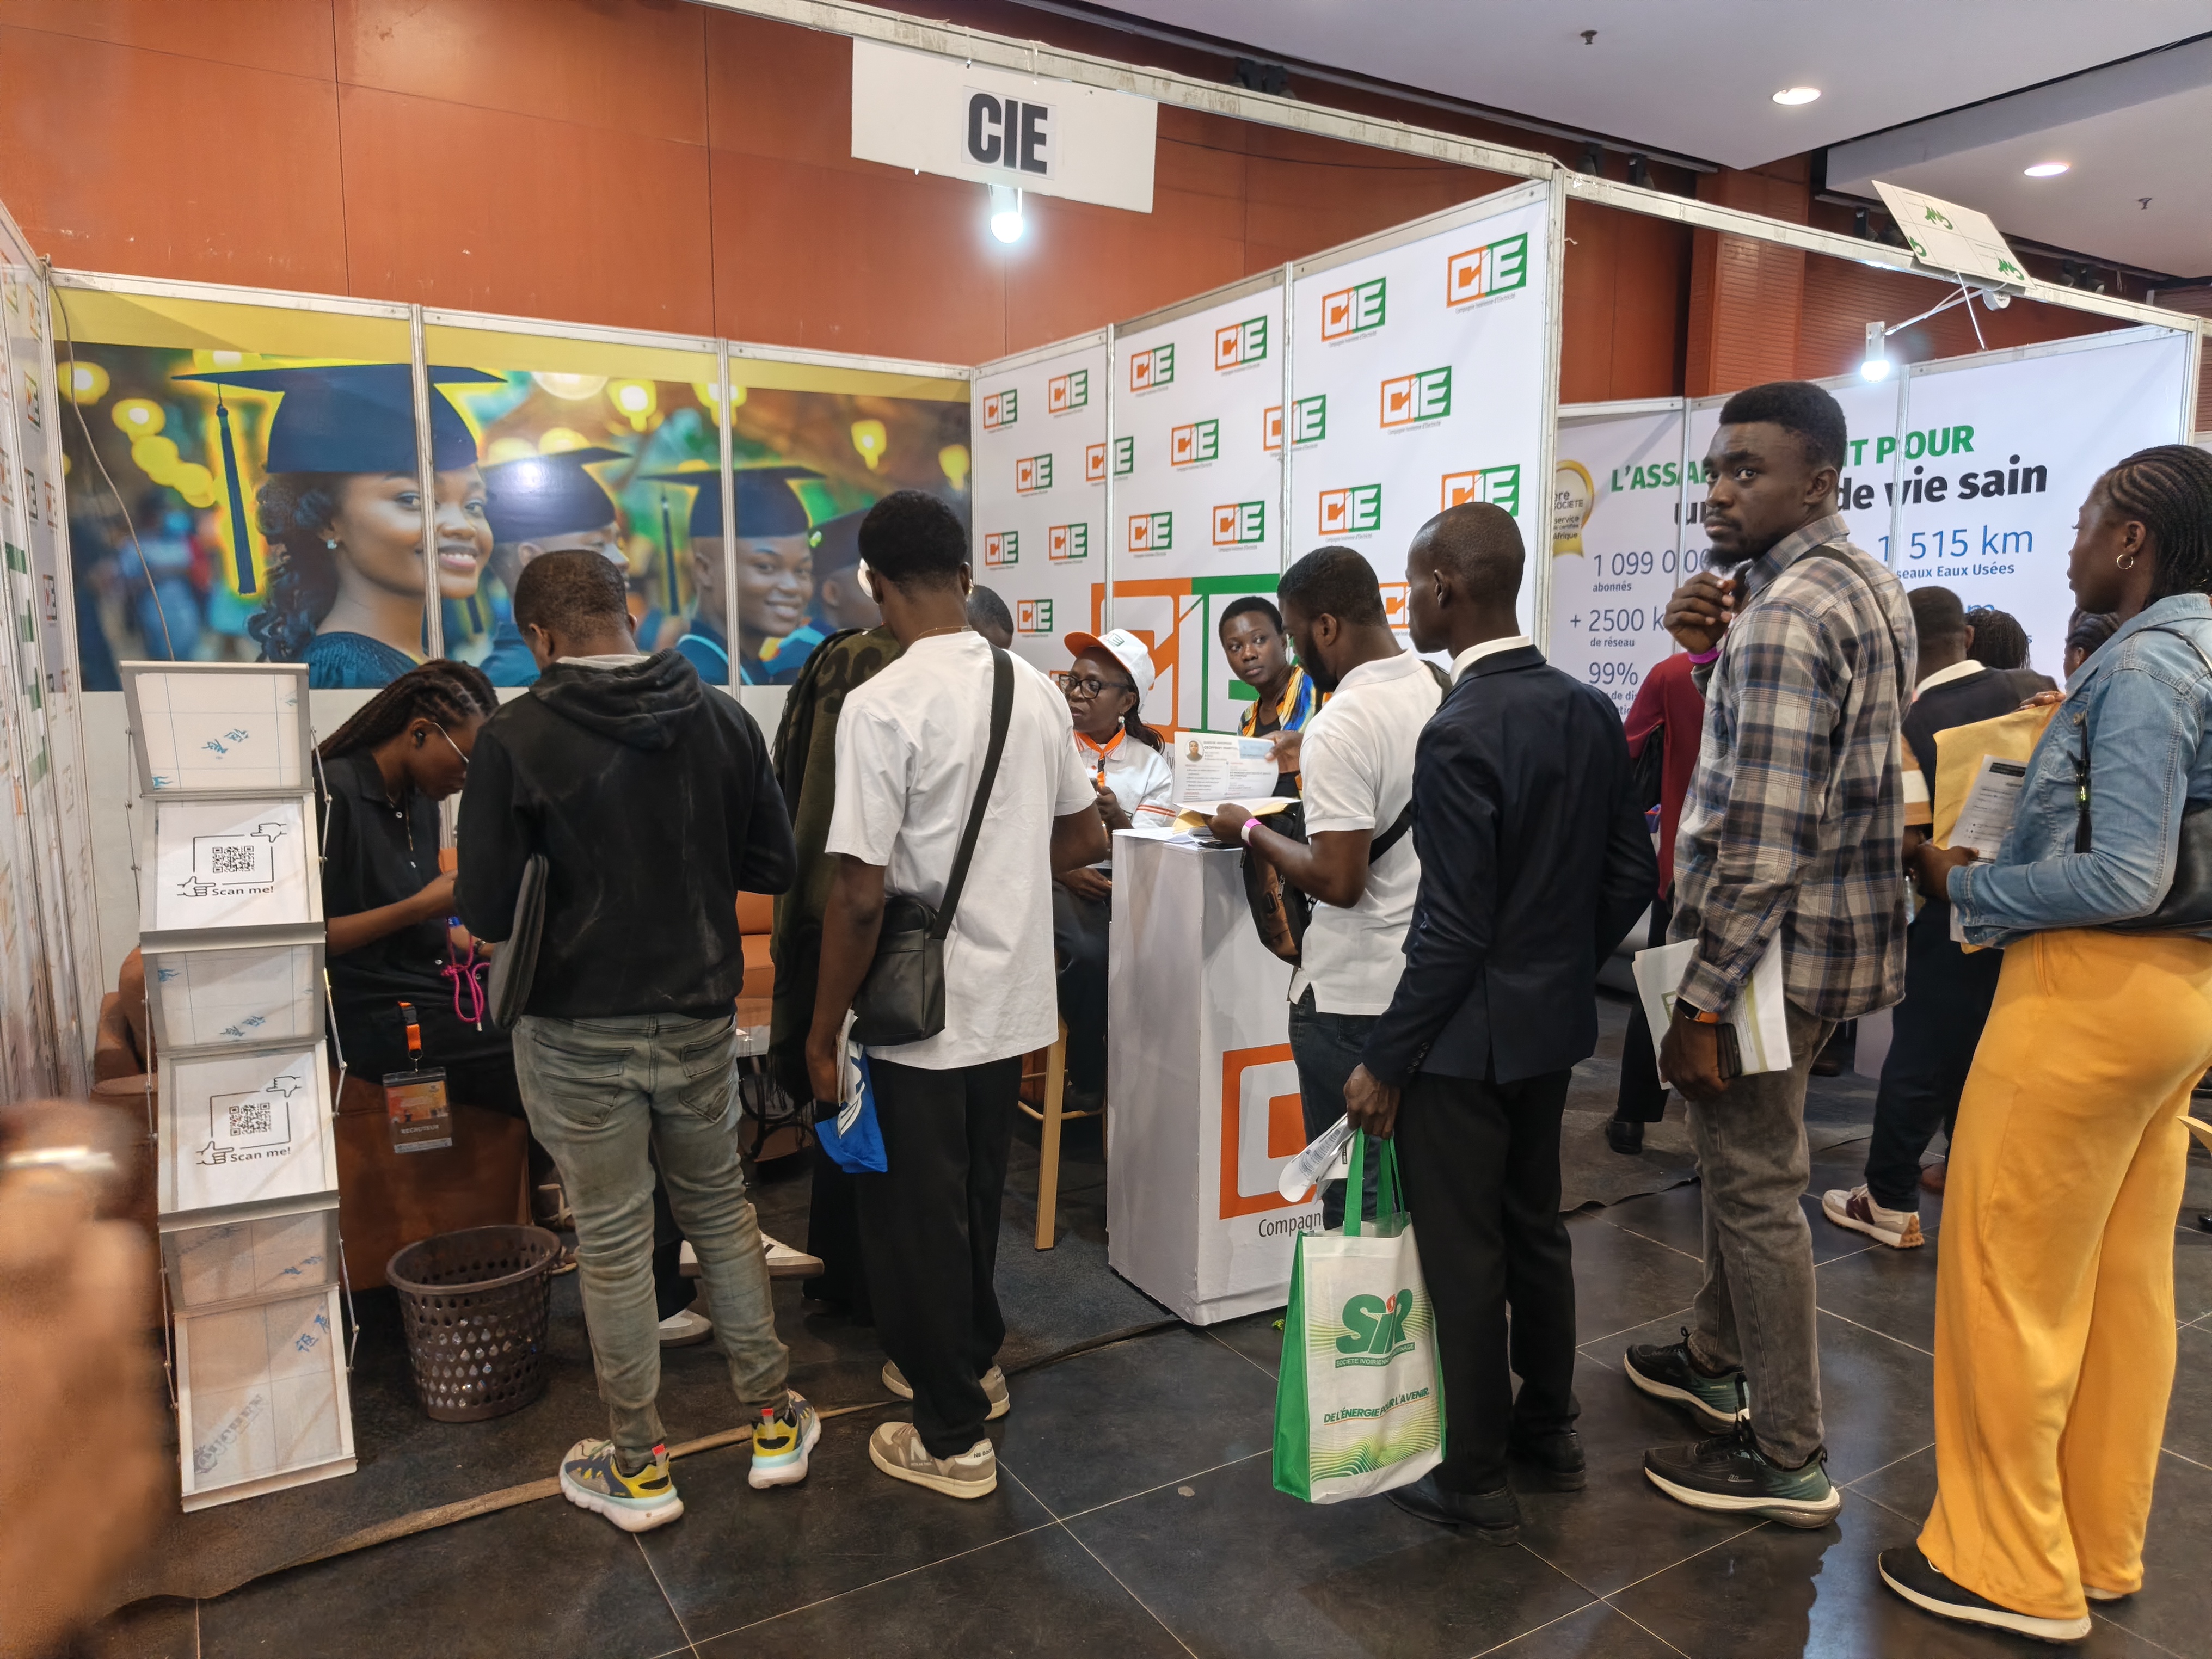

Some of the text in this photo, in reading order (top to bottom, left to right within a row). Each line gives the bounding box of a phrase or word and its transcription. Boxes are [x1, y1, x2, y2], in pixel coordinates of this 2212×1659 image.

[968, 93, 1048, 175] CIE
[1447, 232, 1527, 308] CIE
[1322, 277, 1386, 342] CIE
[1215, 315, 1267, 371] CIE
[1130, 343, 1174, 392] CIE
[984, 389, 1017, 429] CIE
[1049, 369, 1087, 414] CIE
[1380, 366, 1451, 429] CIE
[1086, 436, 1133, 481] CE
[1171, 419, 1219, 467] CIE
[1876, 425, 1974, 464] POUR
[1016, 453, 1052, 493] CIE
[1884, 465, 1948, 507] vie
[1957, 454, 2048, 500] sain
[1212, 501, 1264, 546] CIE
[1319, 483, 1381, 536] CIE
[985, 531, 1018, 566] CIE
[1049, 523, 1087, 561] CIE
[1128, 512, 1172, 552] CIE
[1909, 529, 1968, 560] 515
[1982, 524, 2033, 556] km
[1594, 555, 1602, 577] 1
[1612, 551, 1654, 576] 099
[1897, 562, 2015, 580] seaux Eaux Usées
[1593, 580, 1632, 592] abonnés
[1017, 599, 1053, 632] CIE
[1589, 608, 1644, 632] 2500
[1652, 606, 1664, 631] k
[1590, 636, 1635, 647] de réseau
[1589, 662, 1638, 686] 99%
[211, 885, 274, 896] Scan me!
[230, 1146, 291, 1163] Scan me!
[1258, 1212, 1322, 1238] Compagn
[1324, 1414, 1335, 1423] DE
[1336, 1407, 1380, 1421] L'ÉNERGIE
[1380, 1398, 1394, 1416] POUR
